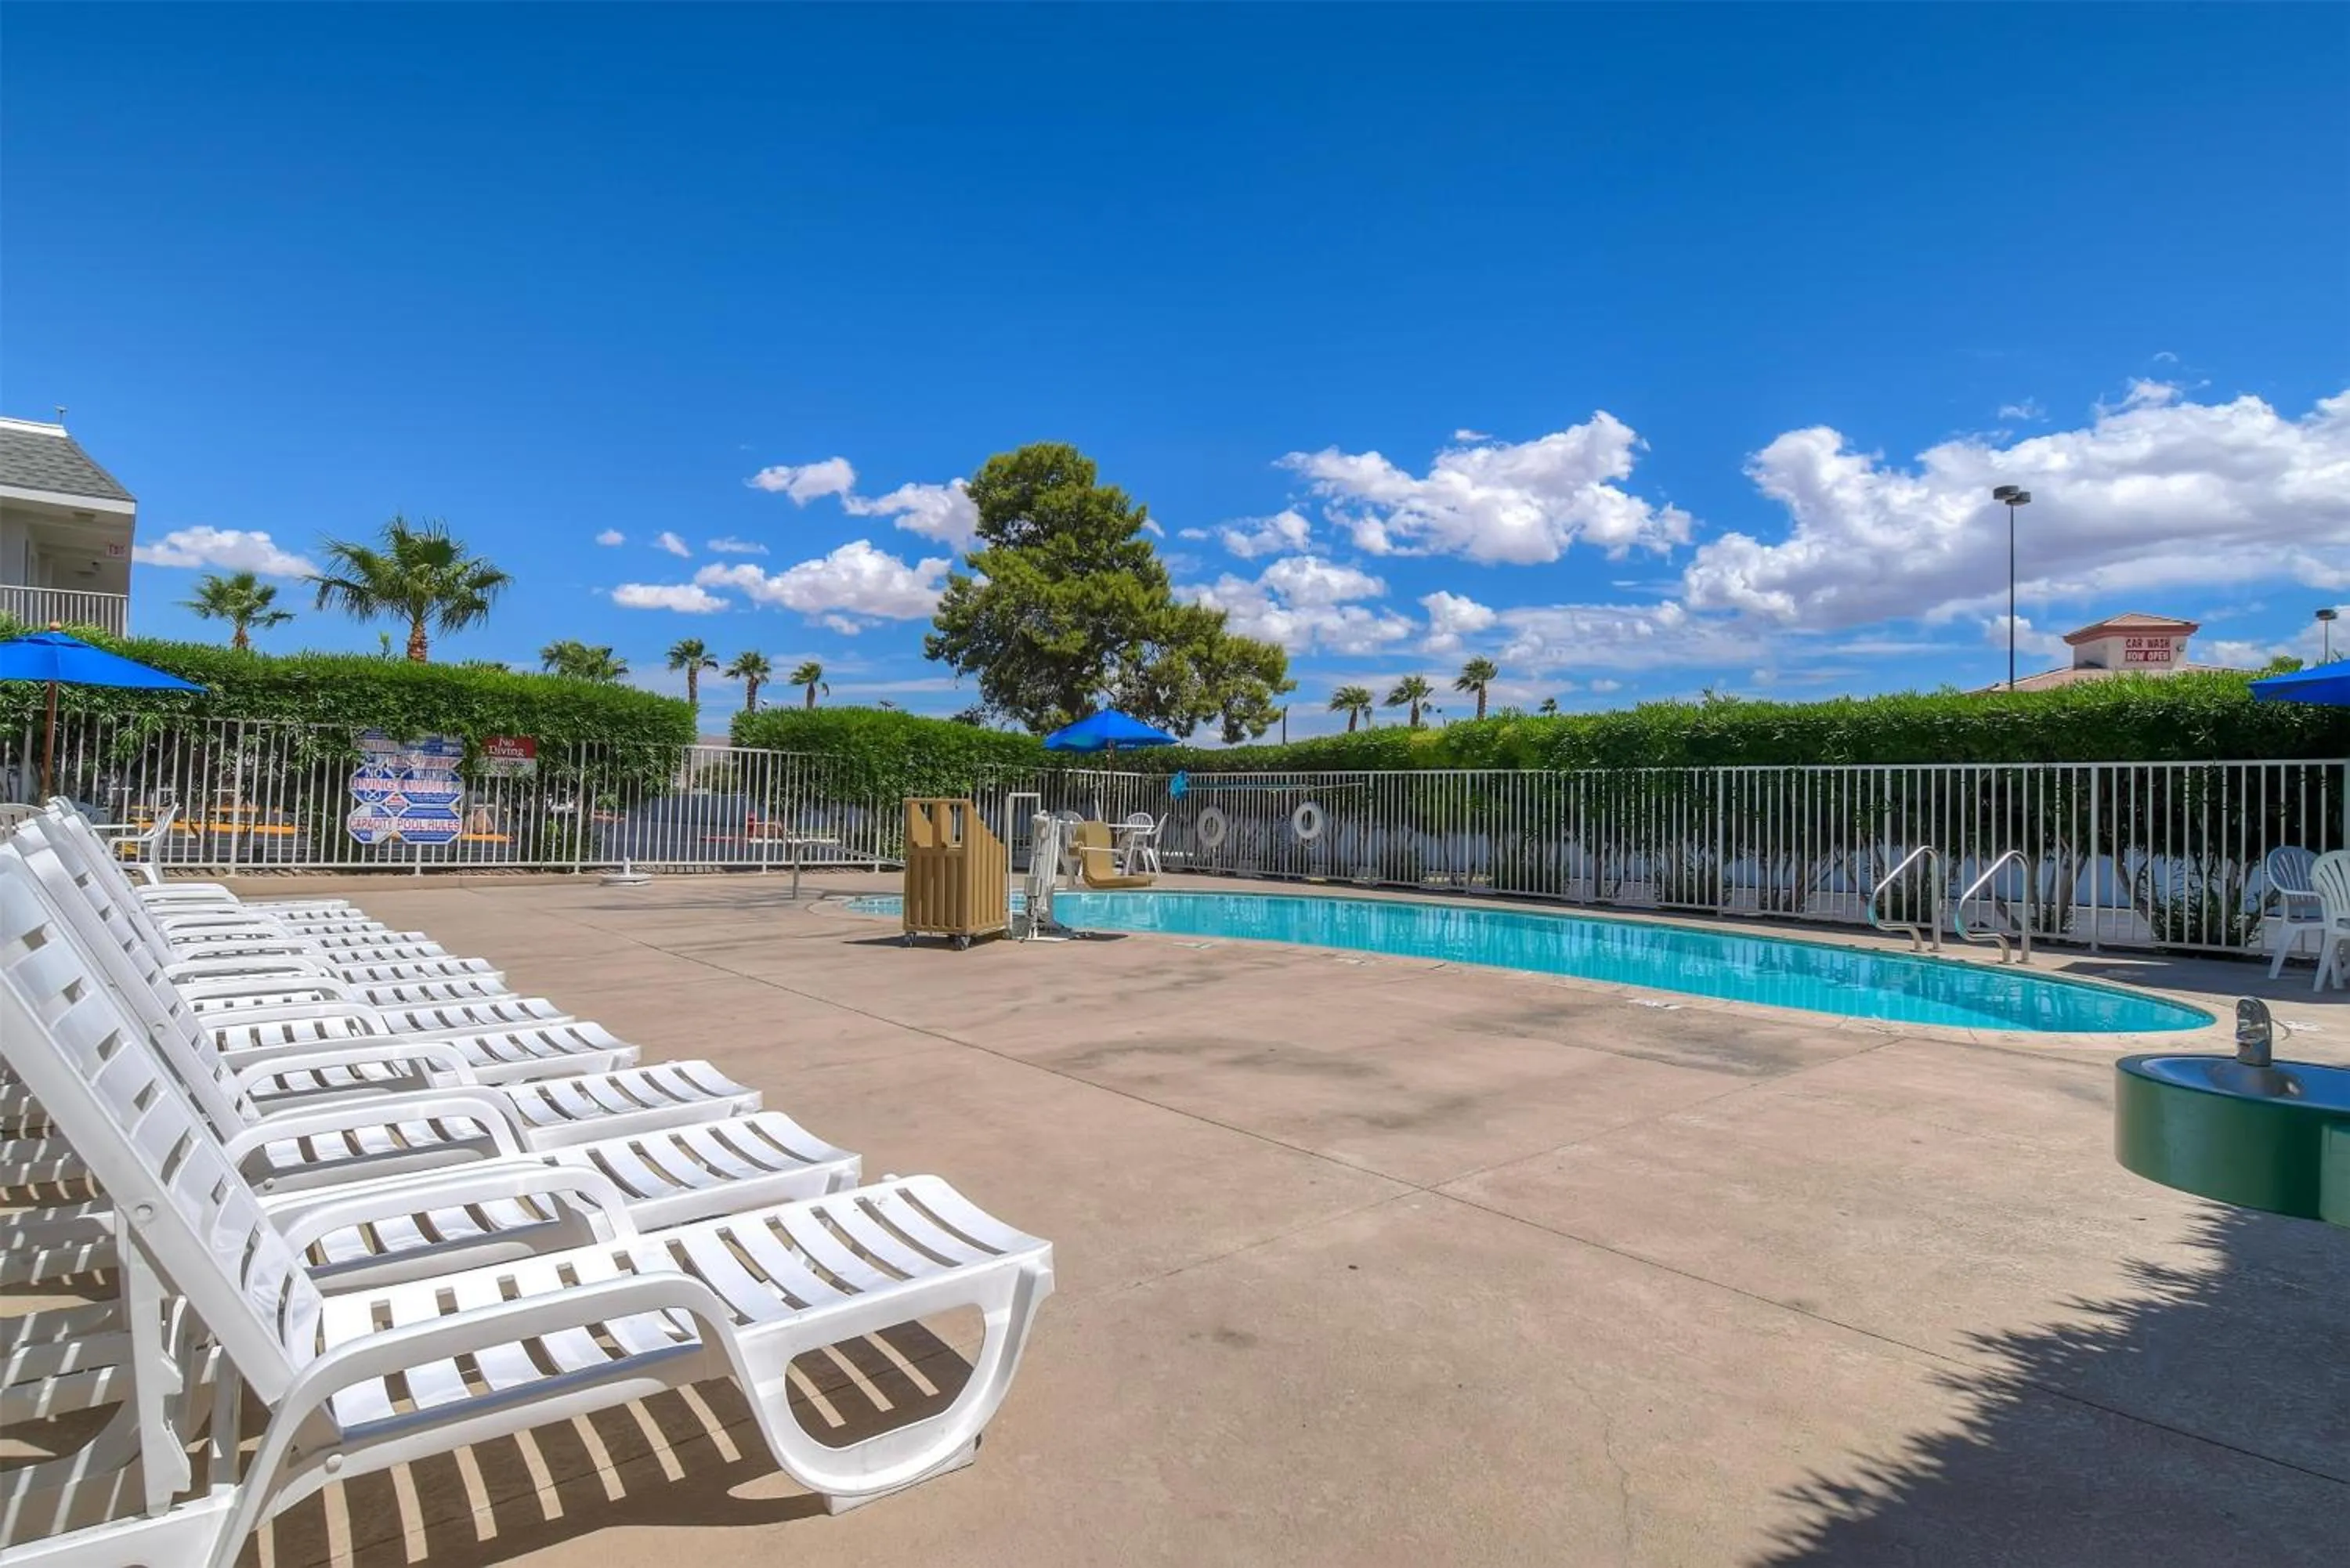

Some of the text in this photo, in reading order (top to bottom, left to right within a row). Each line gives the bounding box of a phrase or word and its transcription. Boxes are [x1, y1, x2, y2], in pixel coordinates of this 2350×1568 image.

[2125, 638, 2171, 649] CAR WASH
[2127, 652, 2169, 660] NOW OPEN
[499, 738, 515, 746] No
[488, 745, 524, 757] Diving
[366, 768, 383, 778] NO
[349, 818, 392, 830] CAPACITY
[397, 819, 425, 829] POOL
